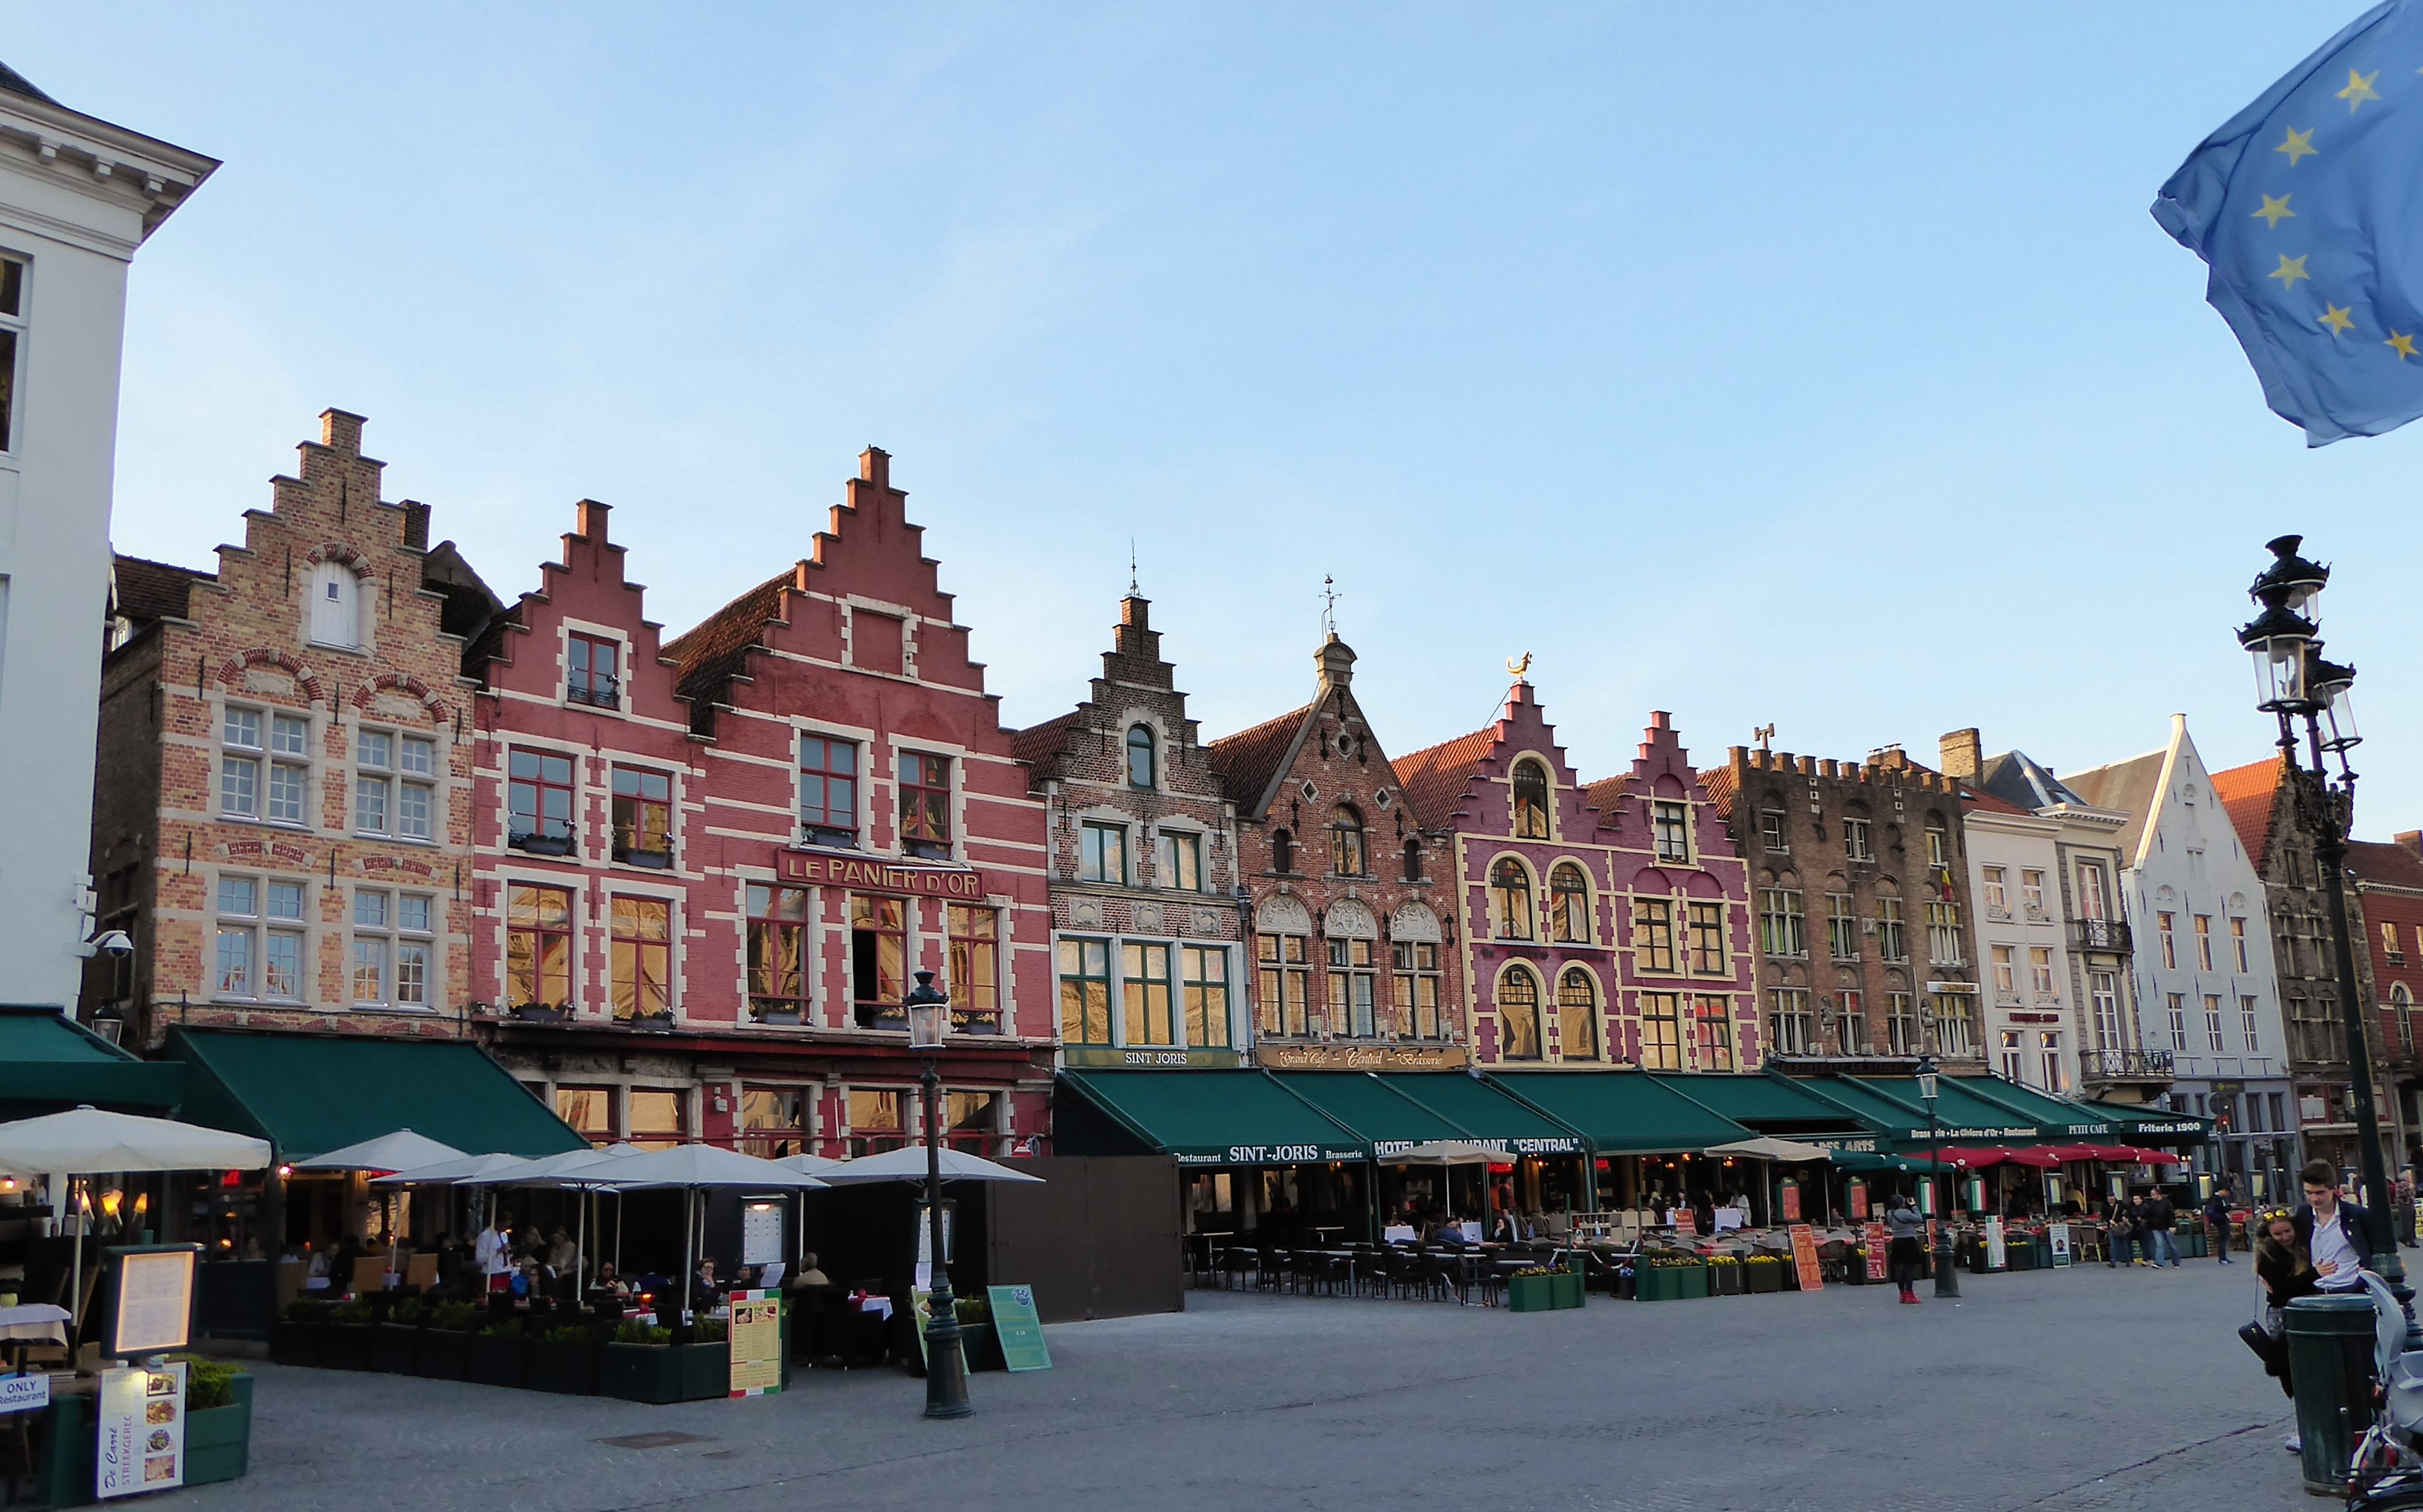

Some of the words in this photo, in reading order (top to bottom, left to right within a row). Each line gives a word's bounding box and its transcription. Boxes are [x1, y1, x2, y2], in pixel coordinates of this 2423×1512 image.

[788, 859, 821, 878] LE
[829, 859, 918, 889] PANIER
[926, 872, 978, 895] D'OR
[1126, 1052, 1152, 1063] SINT
[1156, 1053, 1187, 1064] JORIS
[1346, 1047, 1383, 1068] Central
[1399, 1053, 1443, 1065] Brasserie
[1911, 1128, 1945, 1138] Brassrie
[1950, 1129, 1960, 1137] La
[2068, 1125, 2088, 1134] PETIT
[2176, 1122, 2200, 1131] 1900
[1513, 1138, 1579, 1152] "CENTRAL"
[1844, 1140, 1875, 1152] ARTS
[1230, 1145, 1318, 1161] SINT-JORIS
[1325, 1150, 1363, 1160] Brasserie
[6, 1380, 37, 1394] ONLY
[104, 1469, 116, 1489] De
